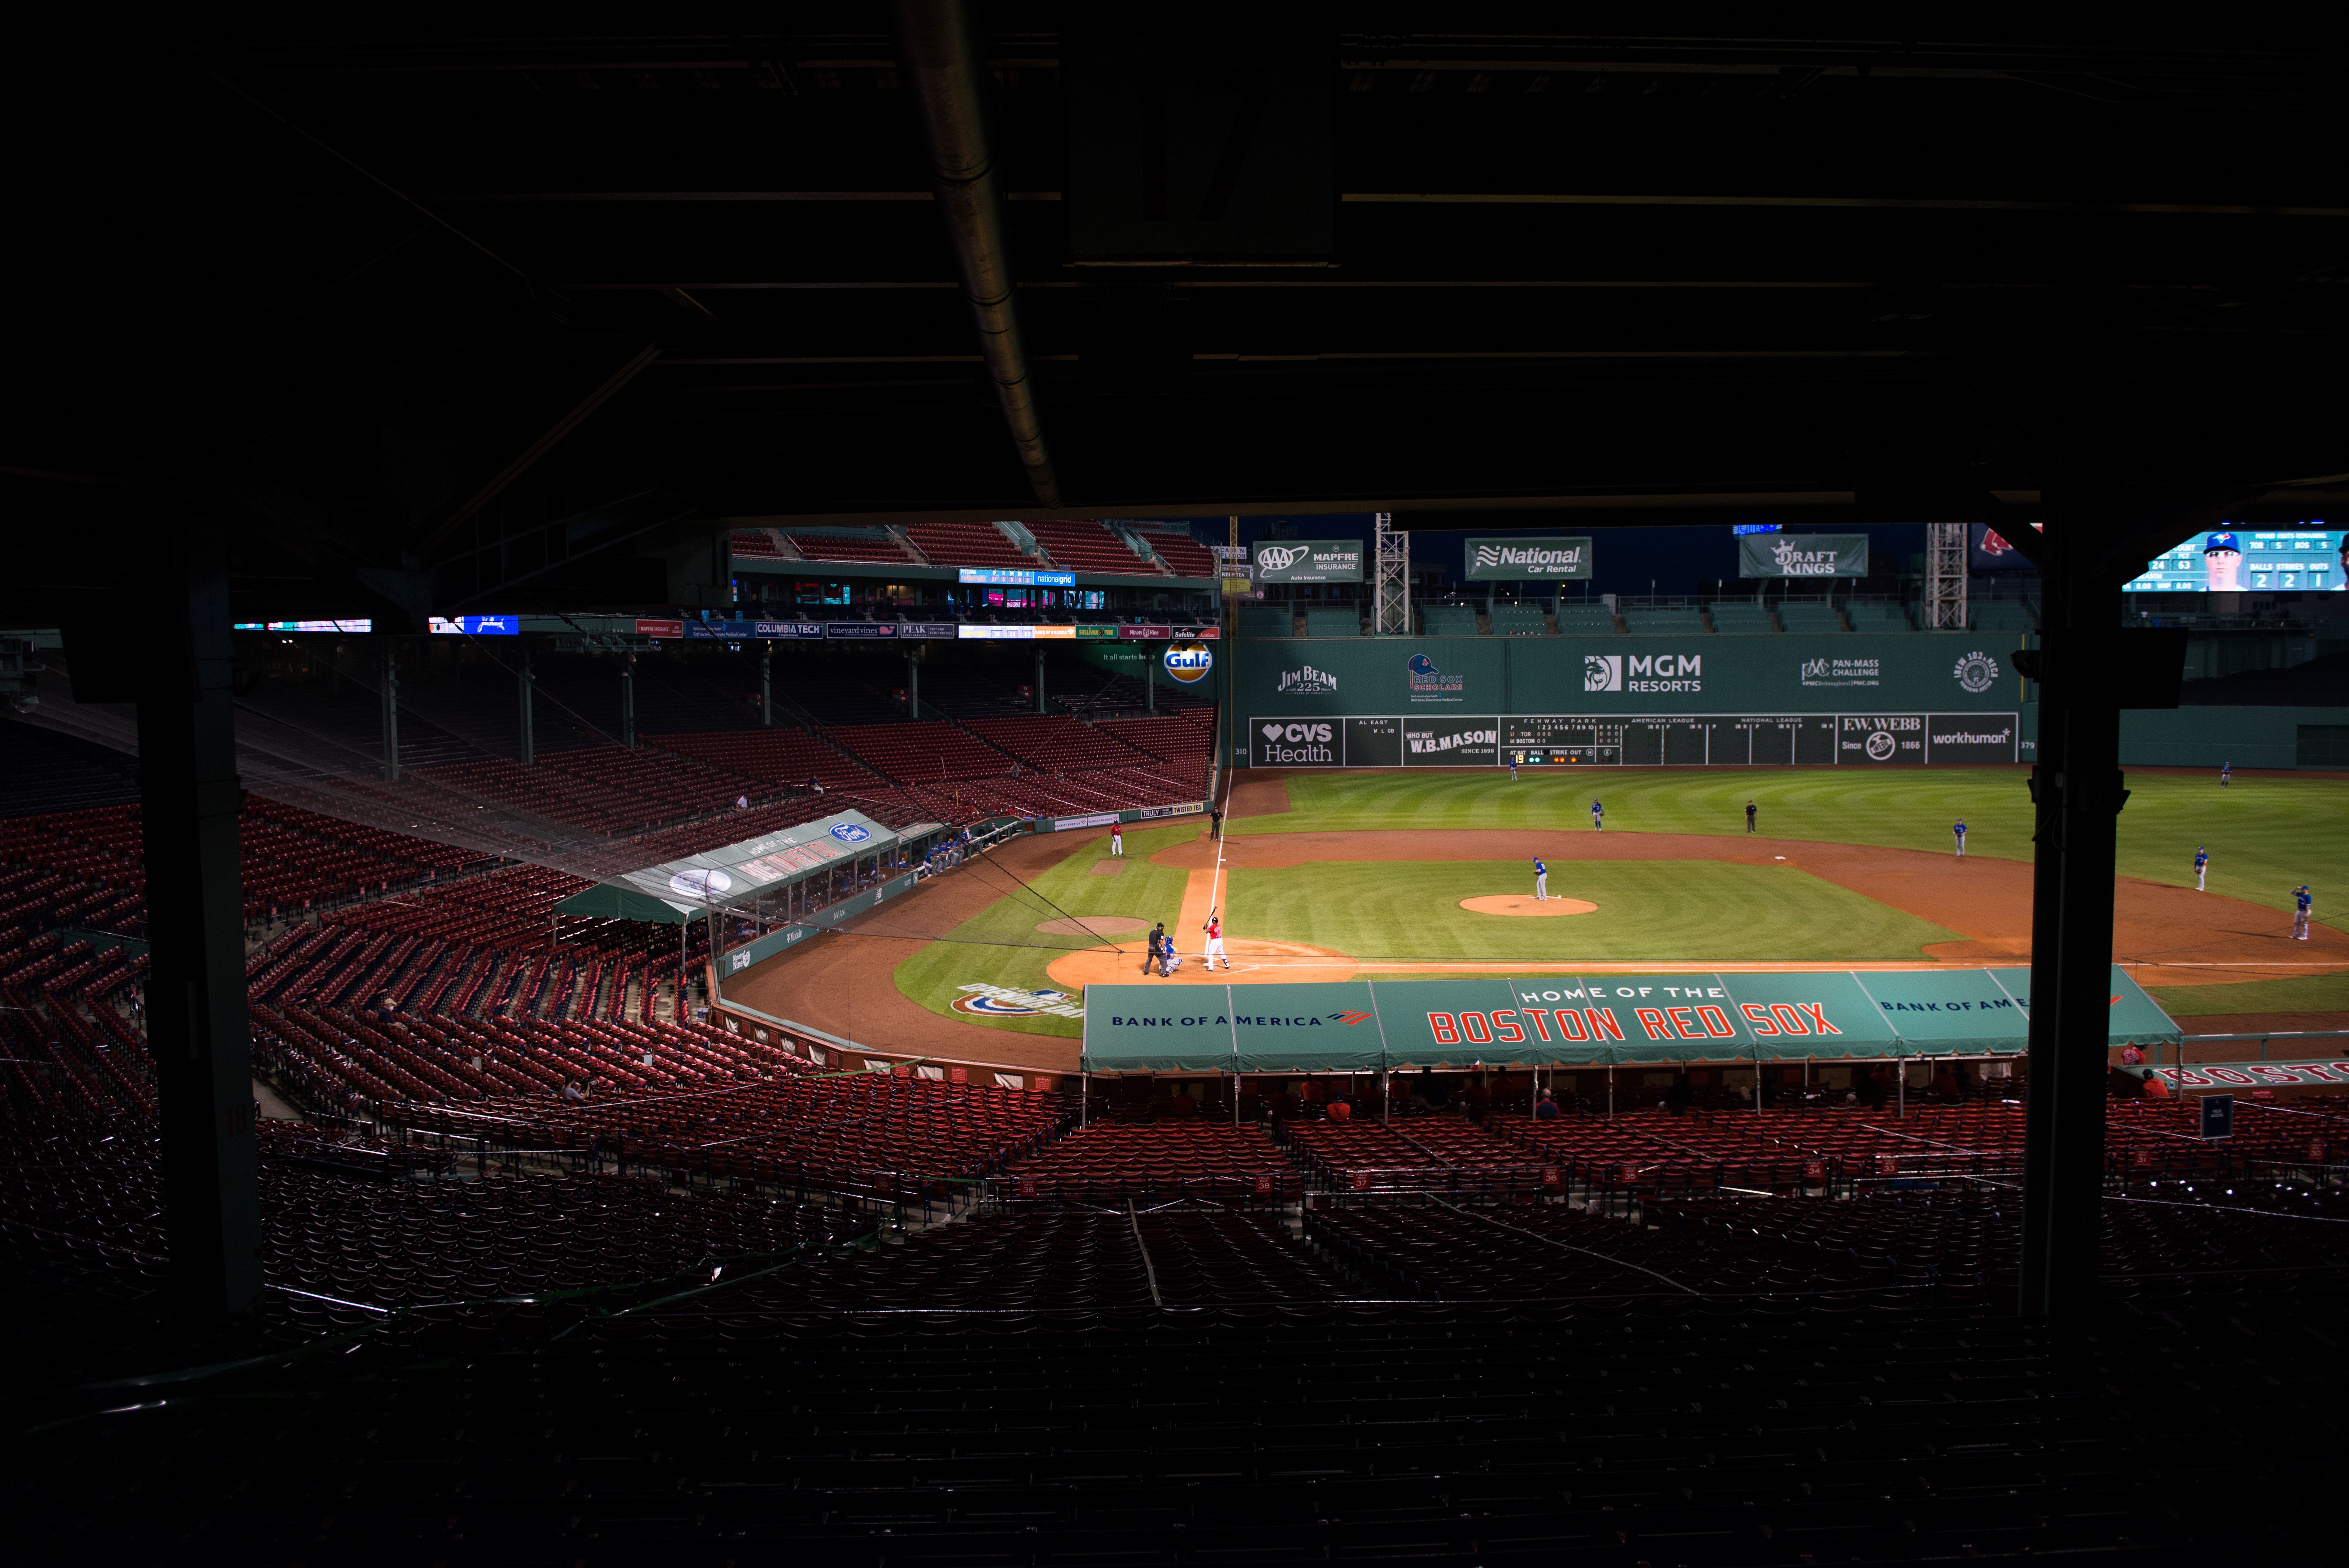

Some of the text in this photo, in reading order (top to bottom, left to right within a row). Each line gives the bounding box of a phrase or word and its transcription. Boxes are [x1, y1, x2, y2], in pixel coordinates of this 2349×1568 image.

[1135, 69, 1271, 221] 17
[1262, 547, 1290, 570] AAA
[1314, 553, 1358, 561] MAPFRE
[1500, 546, 1580, 564] National
[1775, 551, 1838, 565] DRAFT
[1783, 563, 1836, 574] KINGS
[2152, 561, 2190, 569] 24 63
[1037, 575, 1071, 584] nationalgrid
[2256, 575, 2266, 588] 2
[2285, 575, 2294, 587] 2
[757, 624, 820, 633] COLUMBIA TECH
[830, 626, 859, 636] vineyard
[903, 625, 926, 633] PEAK
[1166, 653, 1209, 667] Gulf
[1629, 655, 1701, 677] MGM
[1833, 659, 1879, 668] PAN-MASS
[1278, 666, 1337, 692] JIM BEAM
[1297, 683, 1320, 692] 225
[1629, 680, 1701, 692] RESORTS
[1843, 717, 1920, 731] F.W. WEBB
[1285, 724, 1332, 742] CVS
[1265, 744, 1332, 762] Health
[1516, 755, 1524, 763] 19
[834, 823, 866, 841] Ford
[749, 844, 767, 856] HOME
[765, 841, 776, 849] OF
[733, 951, 743, 962] Ninety
[733, 960, 743, 970] Nine
[957, 983, 1058, 1008] OPENING
[1521, 987, 1724, 1002] HOME OF THE
[1881, 999, 2030, 1011] BANK OF AME
[1112, 1015, 1322, 1026] BANK OF AMERICA
[1427, 1002, 1843, 1044] BOSTON RED SOX
[226, 1102, 246, 1138] 18
